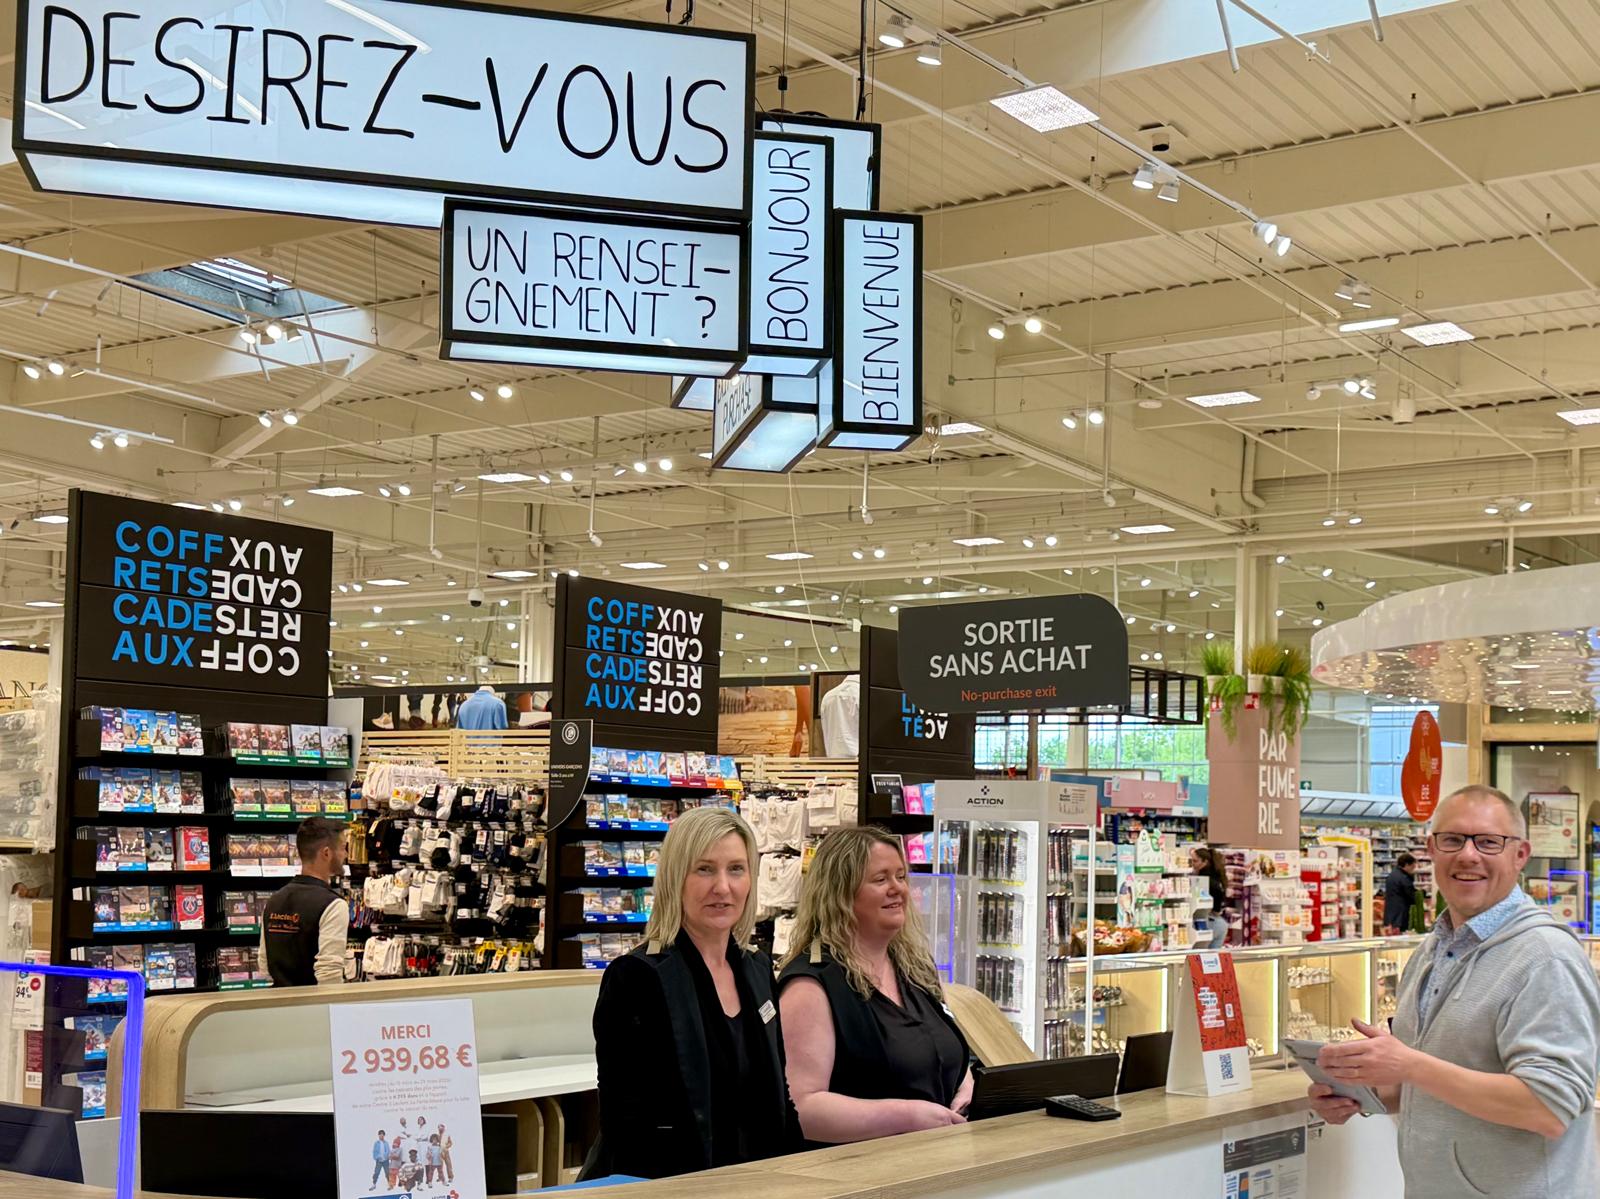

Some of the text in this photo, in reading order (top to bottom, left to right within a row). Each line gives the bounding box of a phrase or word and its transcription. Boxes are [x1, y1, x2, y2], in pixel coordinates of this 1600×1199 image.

[38, 5, 730, 173] DESIREZ-VOUS
[467, 226, 731, 289] UN RENSEI-
[767, 147, 811, 342] BONJOUR
[465, 279, 717, 339] GNEMENT ?
[862, 223, 900, 422] BIENVENUE
[115, 520, 224, 563] COFF
[228, 536, 303, 575] AUX
[114, 556, 208, 597] RETS
[210, 569, 302, 609] CADE
[113, 593, 213, 632] CADE
[215, 604, 301, 642] RETS
[587, 596, 654, 628] COFF
[656, 606, 704, 635] AUX
[111, 630, 195, 668] AUX
[586, 624, 645, 655] RETS
[645, 632, 703, 663] CADE
[963, 617, 1055, 647] SORTIE
[199, 639, 300, 677] COFF
[585, 653, 647, 683] CADE
[648, 660, 703, 689] RETS
[929, 644, 1092, 679] SANS ACHAT
[584, 682, 636, 711] AUX
[638, 688, 701, 716] COFF
[960, 685, 1057, 704] No-purchase exit
[901, 715, 924, 738] TÉ
[1259, 727, 1288, 762] PAR
[1258, 764, 1296, 799] FUME
[966, 797, 1005, 805] ACTION
[1257, 801, 1284, 835] RIE.
[381, 1024, 431, 1040] MERCI
[341, 1044, 472, 1074] 2 939,68 €
